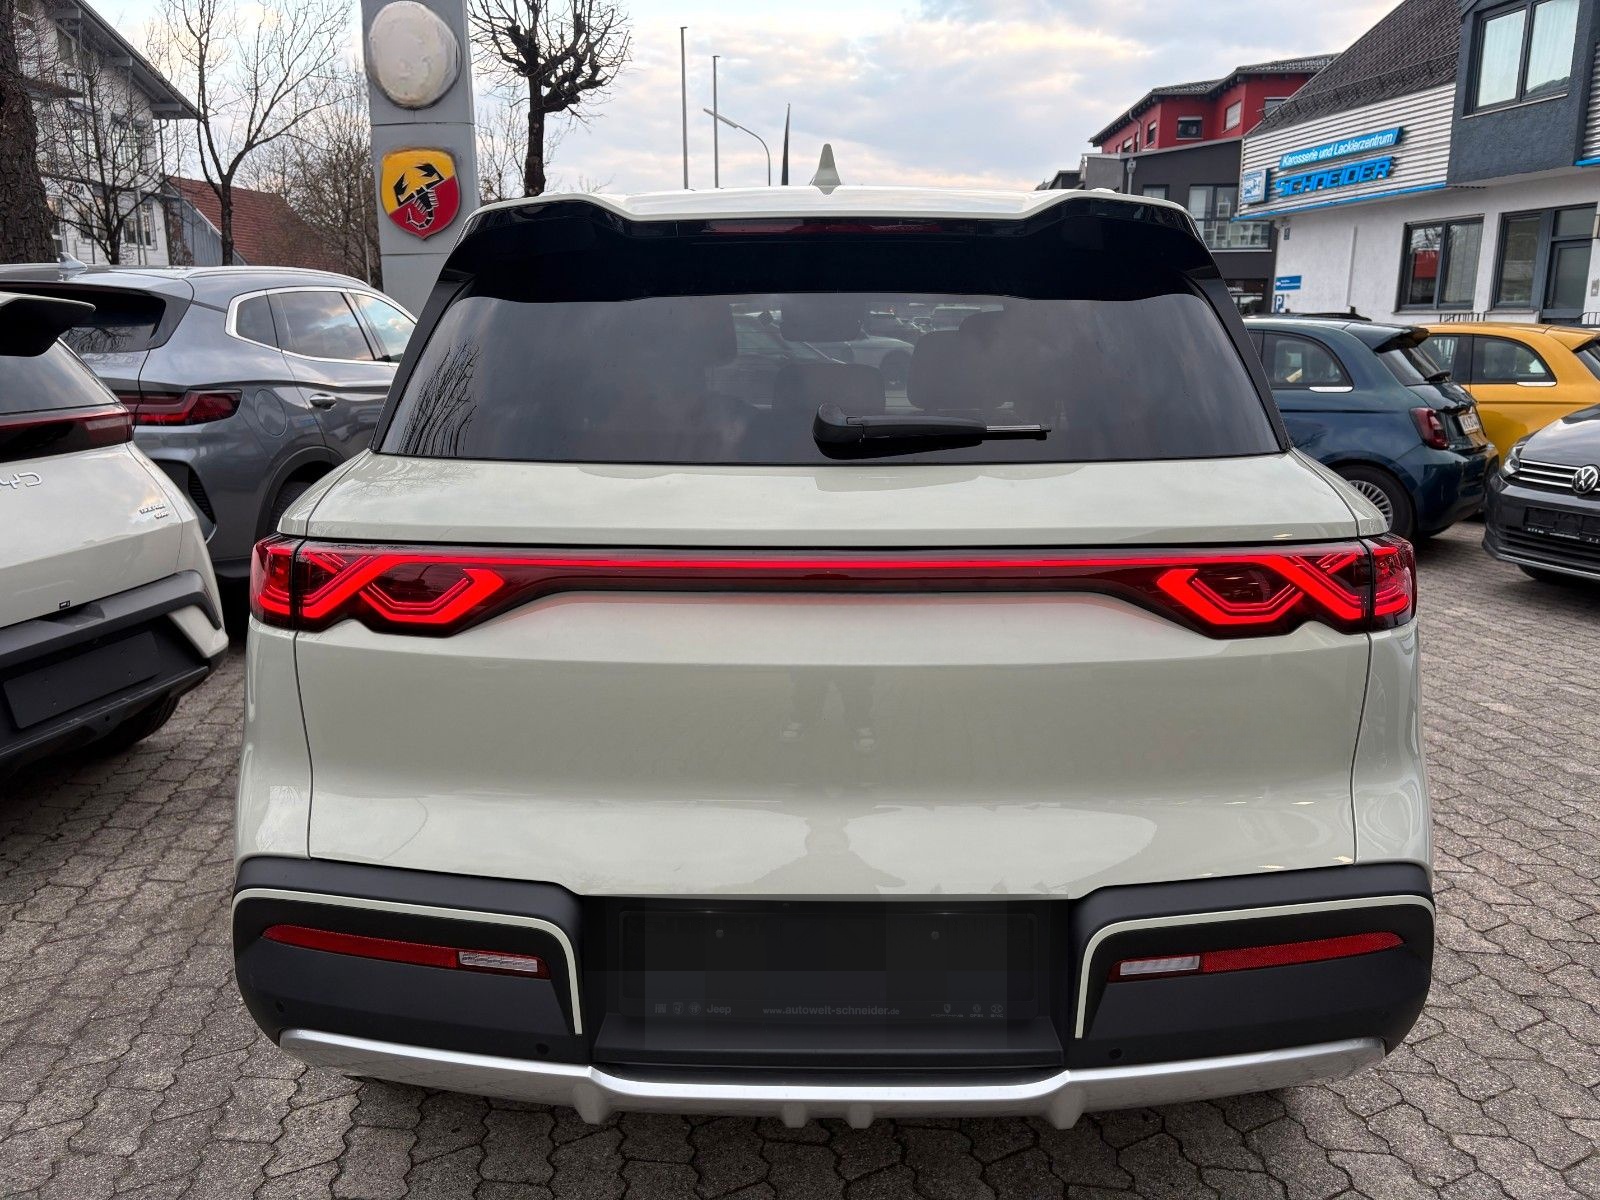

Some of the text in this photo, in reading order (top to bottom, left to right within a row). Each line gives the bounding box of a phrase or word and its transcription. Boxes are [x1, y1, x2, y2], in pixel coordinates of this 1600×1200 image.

[1282, 133, 1393, 167] Karosserie und Lackierzentrum
[1275, 156, 1391, 196] SCHNEIDER
[707, 1003, 731, 1016] Jeep
[762, 1005, 900, 1016] www.autowelt-schneider.de
